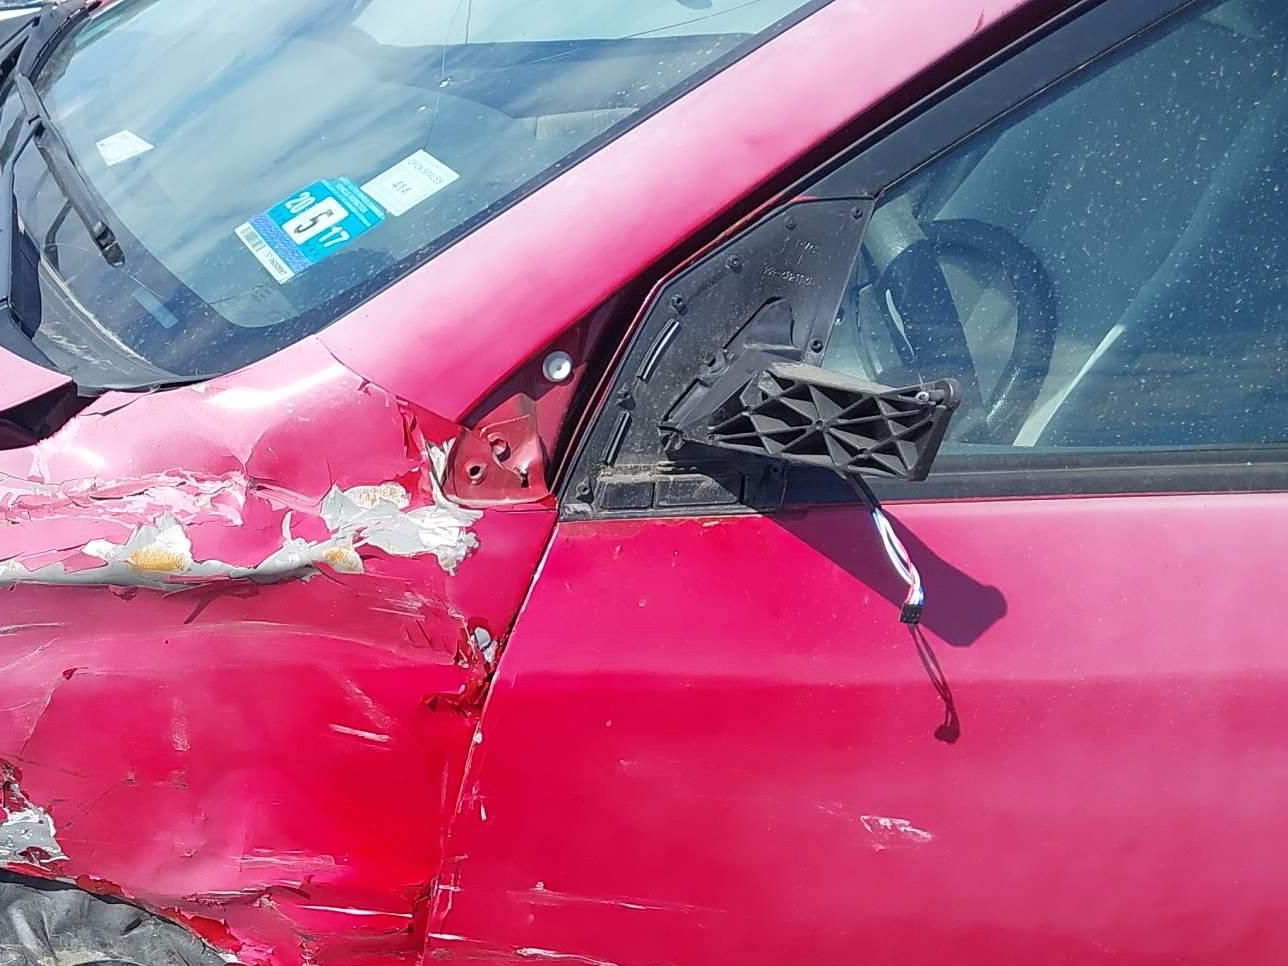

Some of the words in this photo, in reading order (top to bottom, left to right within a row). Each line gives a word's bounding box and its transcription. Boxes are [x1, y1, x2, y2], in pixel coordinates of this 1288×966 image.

[284, 191, 316, 214] 20
[293, 208, 335, 234] 5
[318, 225, 351, 248] 17
